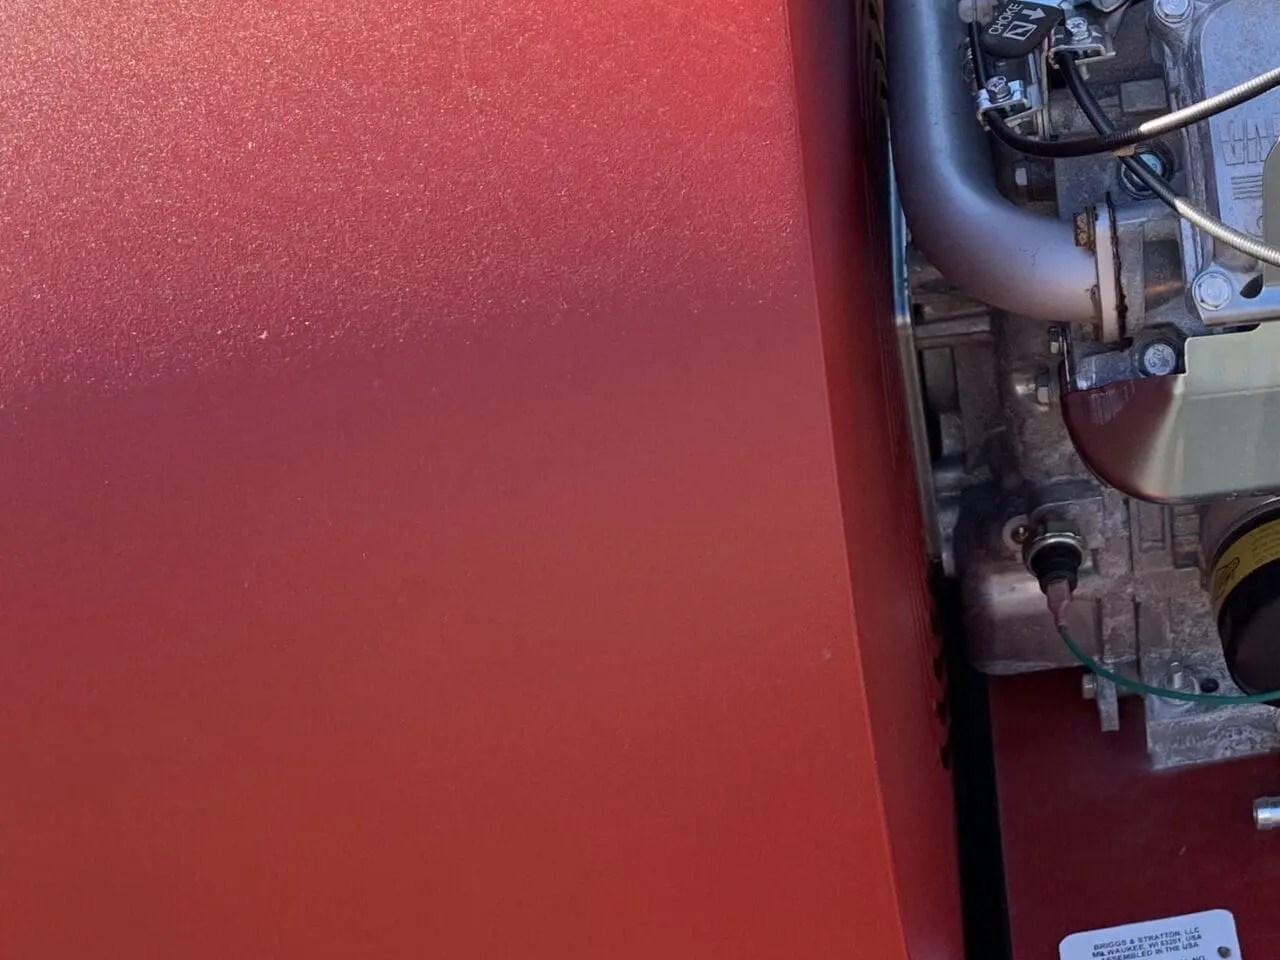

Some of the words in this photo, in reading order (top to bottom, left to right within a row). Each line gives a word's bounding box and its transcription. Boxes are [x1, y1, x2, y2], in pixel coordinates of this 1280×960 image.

[988, 2, 1023, 35] CHOKE
[1093, 940, 1127, 951] BRIGGS
[1184, 926, 1200, 935] LLC
[1182, 941, 1199, 950] USA
[1185, 934, 1203, 942] USA
